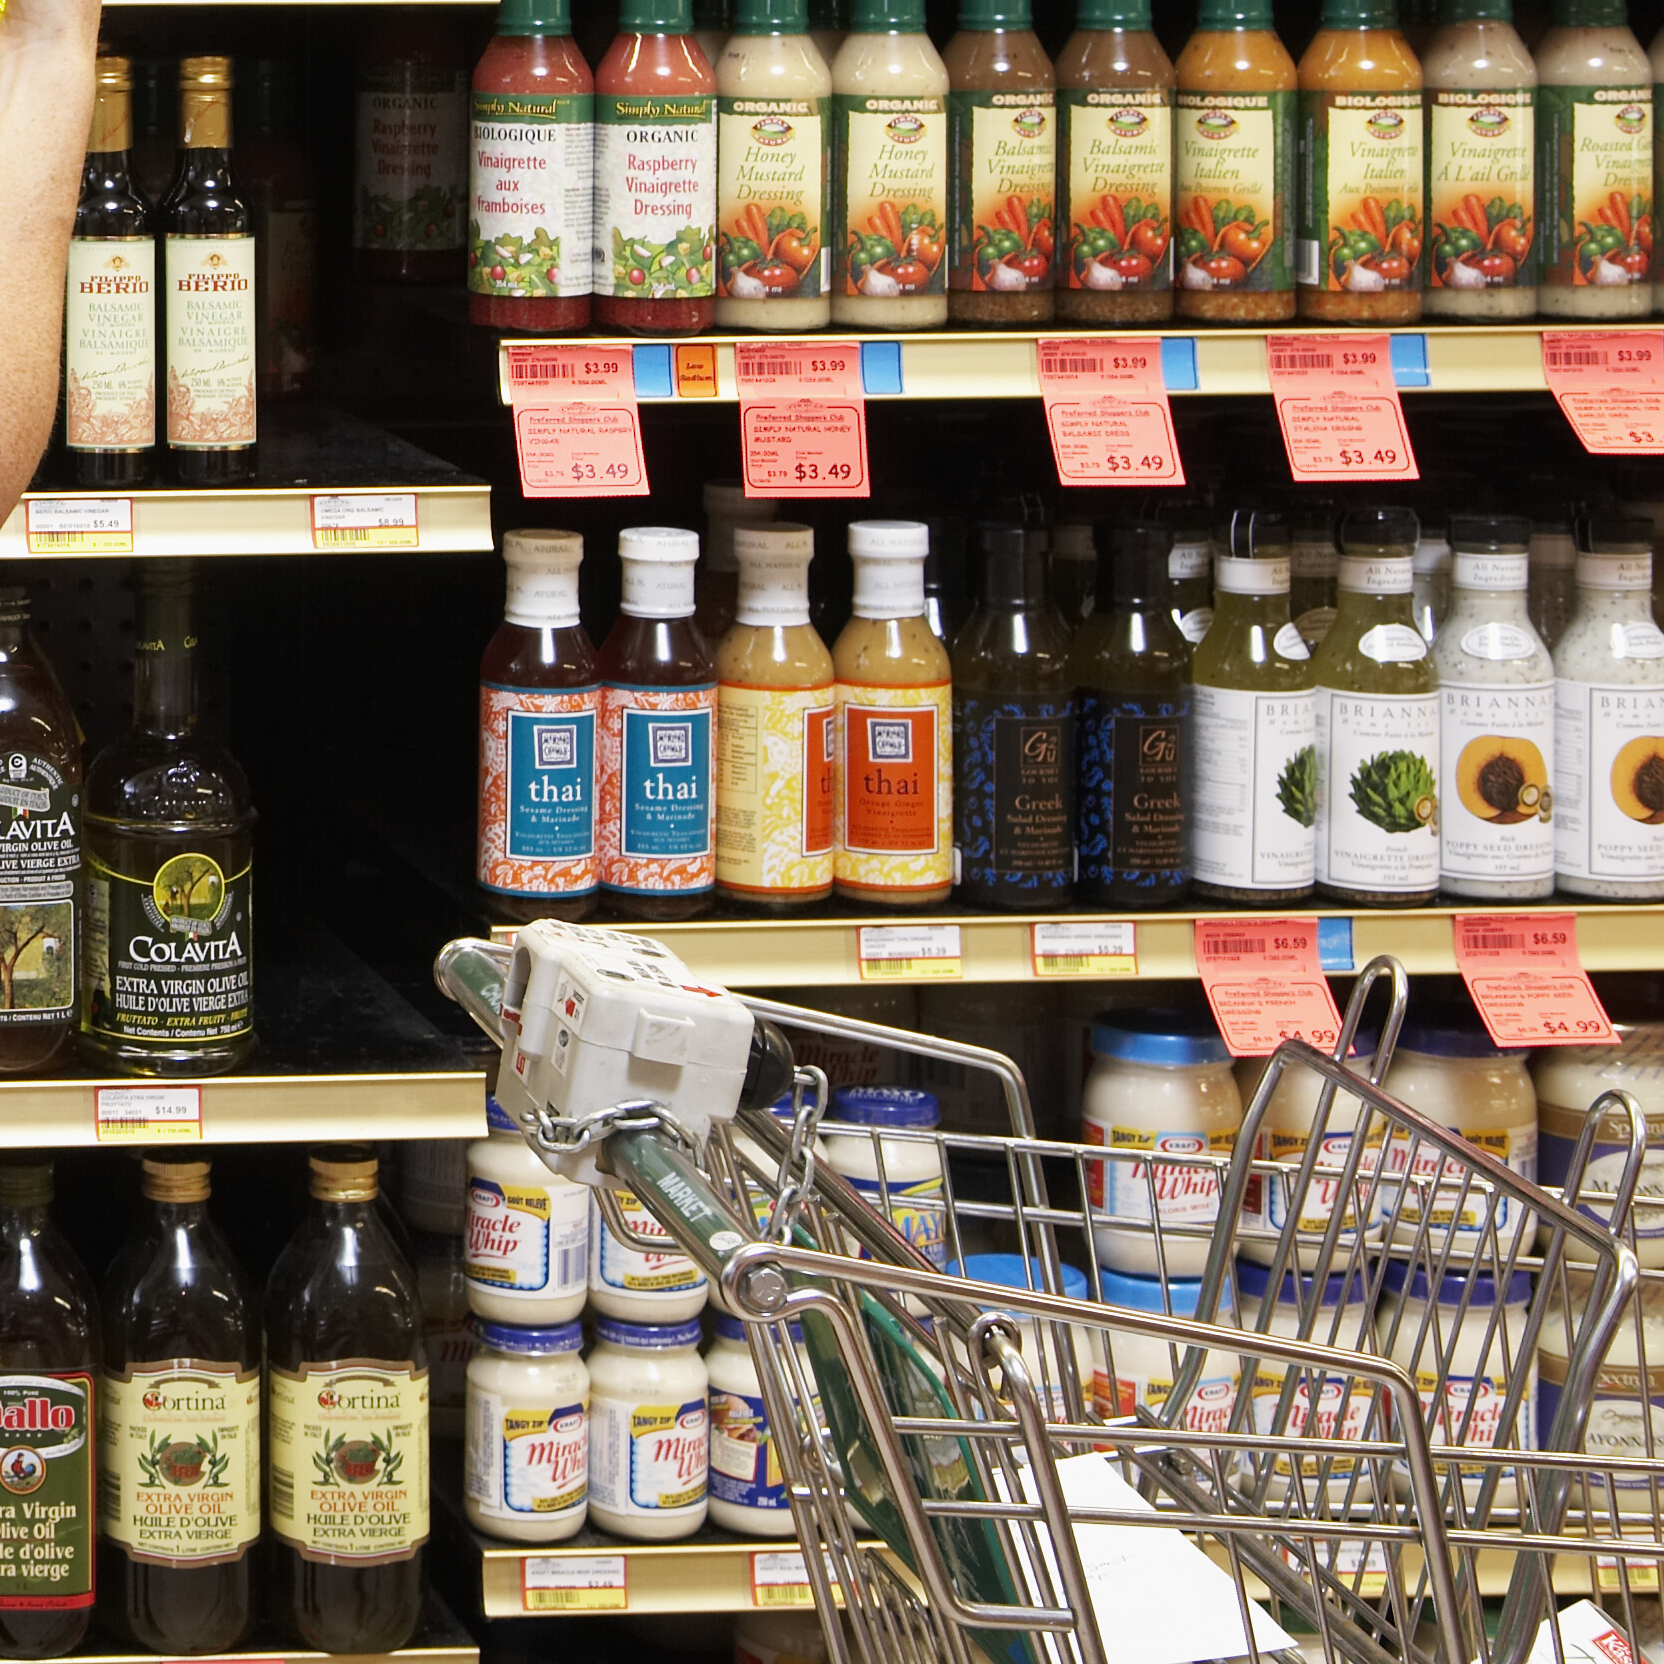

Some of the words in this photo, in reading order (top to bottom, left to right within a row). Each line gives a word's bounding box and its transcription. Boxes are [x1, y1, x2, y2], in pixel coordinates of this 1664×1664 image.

[626, 130, 700, 144] ORGANIC
[627, 153, 698, 174] Raspberry
[625, 177, 700, 196] Vinaigrette
[634, 199, 692, 219] Dressing
[177, 279, 249, 292] BERIO
[584, 362, 619, 373] $3.99
[1340, 448, 1397, 467] $3.49
[572, 463, 629, 482] $3.49
[93, 519, 120, 528] $5.49
[528, 774, 583, 802] thai
[864, 768, 920, 796] thai
[129, 932, 243, 964] COLAVITA
[921, 946, 947, 956] $5.39
[1273, 937, 1308, 950] $6.59
[1544, 1020, 1601, 1035] $4.99
[655, 1172, 716, 1224] MARKET
[136, 1491, 181, 1502] EXTRA
[187, 1490, 234, 1503] VIRGIN
[22, 1501, 78, 1523] Virgin
